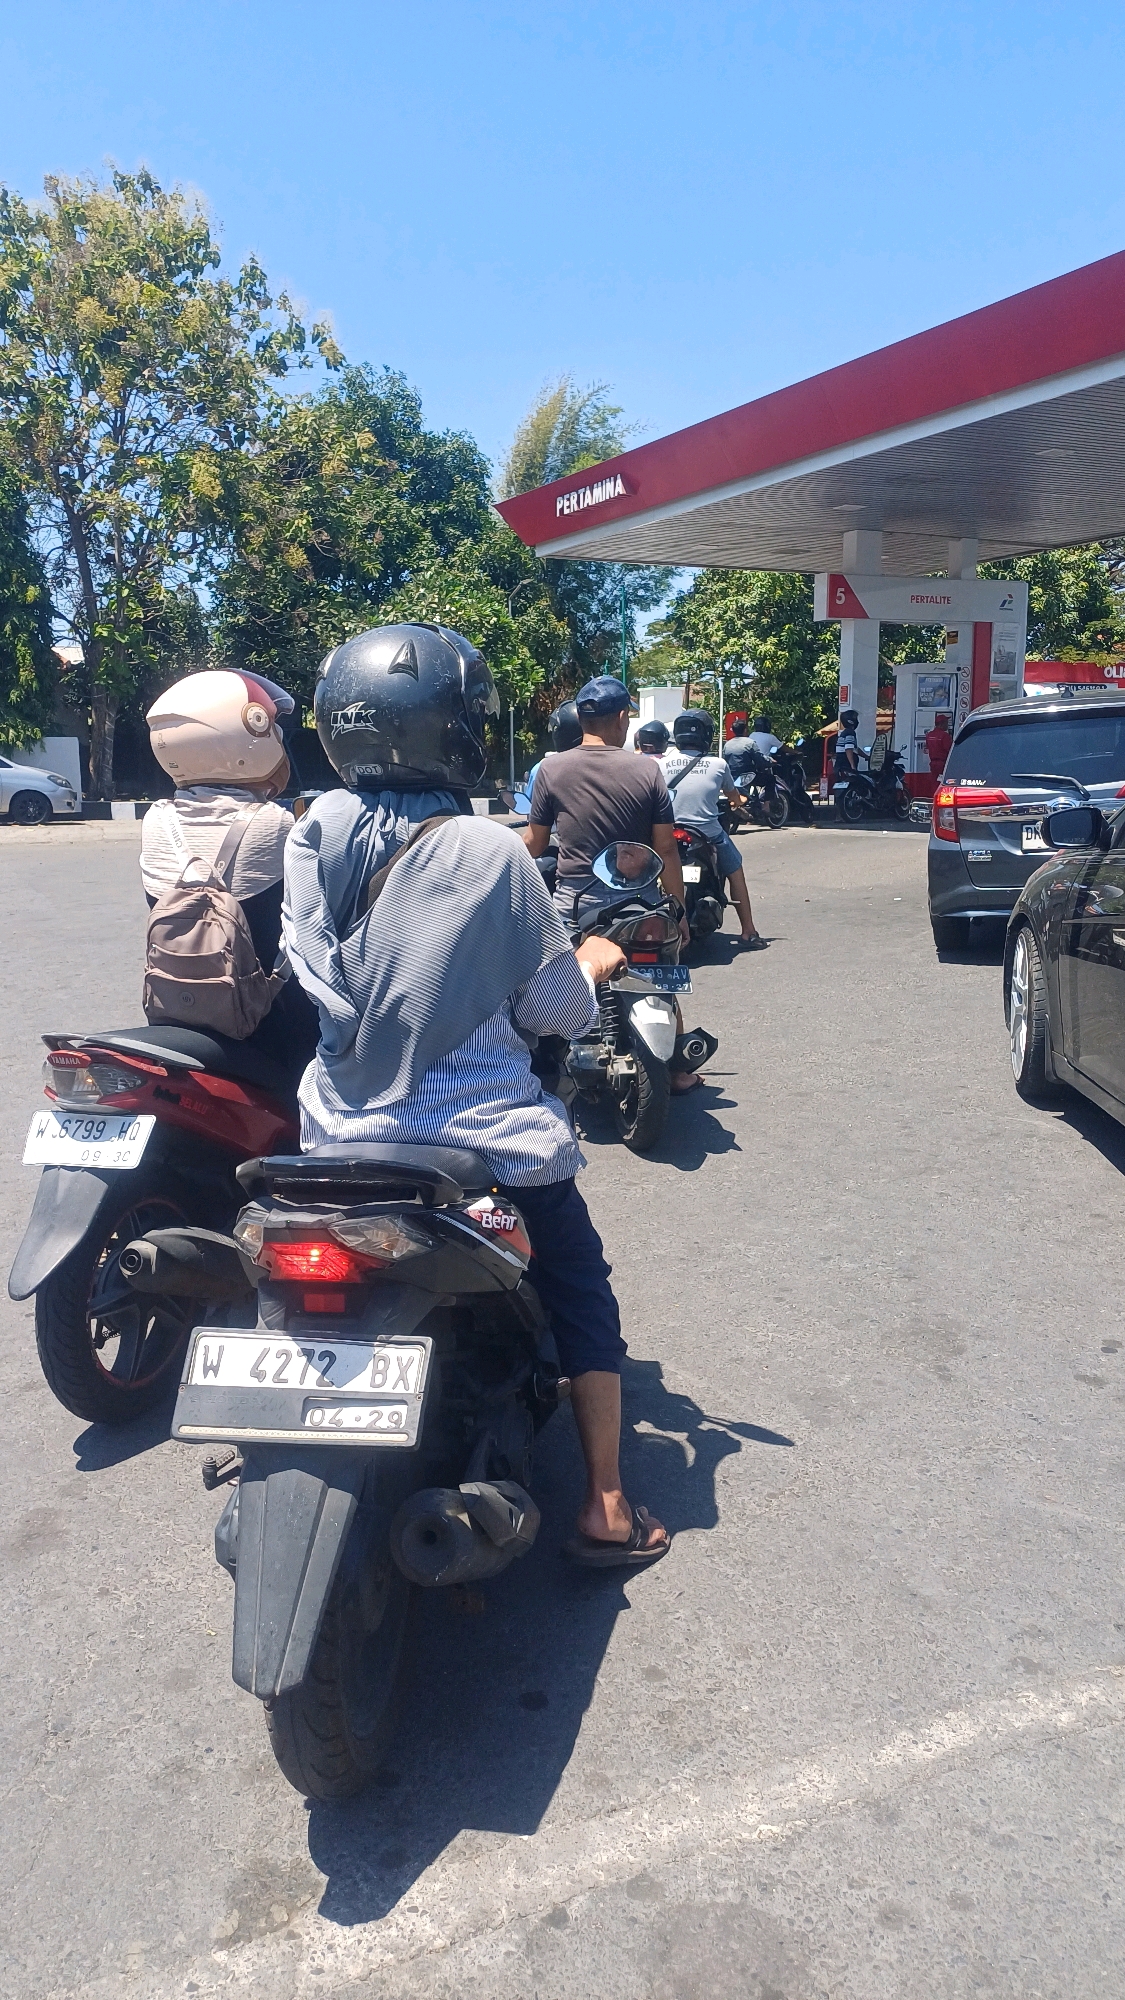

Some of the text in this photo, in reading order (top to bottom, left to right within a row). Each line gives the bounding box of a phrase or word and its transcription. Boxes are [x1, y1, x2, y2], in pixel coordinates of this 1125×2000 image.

[556, 473, 625, 517] PERTAMINA
[835, 587, 846, 605] 5
[910, 595, 952, 604] PERTALITE
[1103, 665, 1125, 679] OLI
[356, 766, 380, 774] DOT
[672, 968, 687, 980] AV
[51, 1055, 81, 1066] YAMAHA
[36, 1118, 50, 1139] W
[59, 1119, 107, 1141] 6799
[203, 1344, 414, 1391] W 4272 BX
